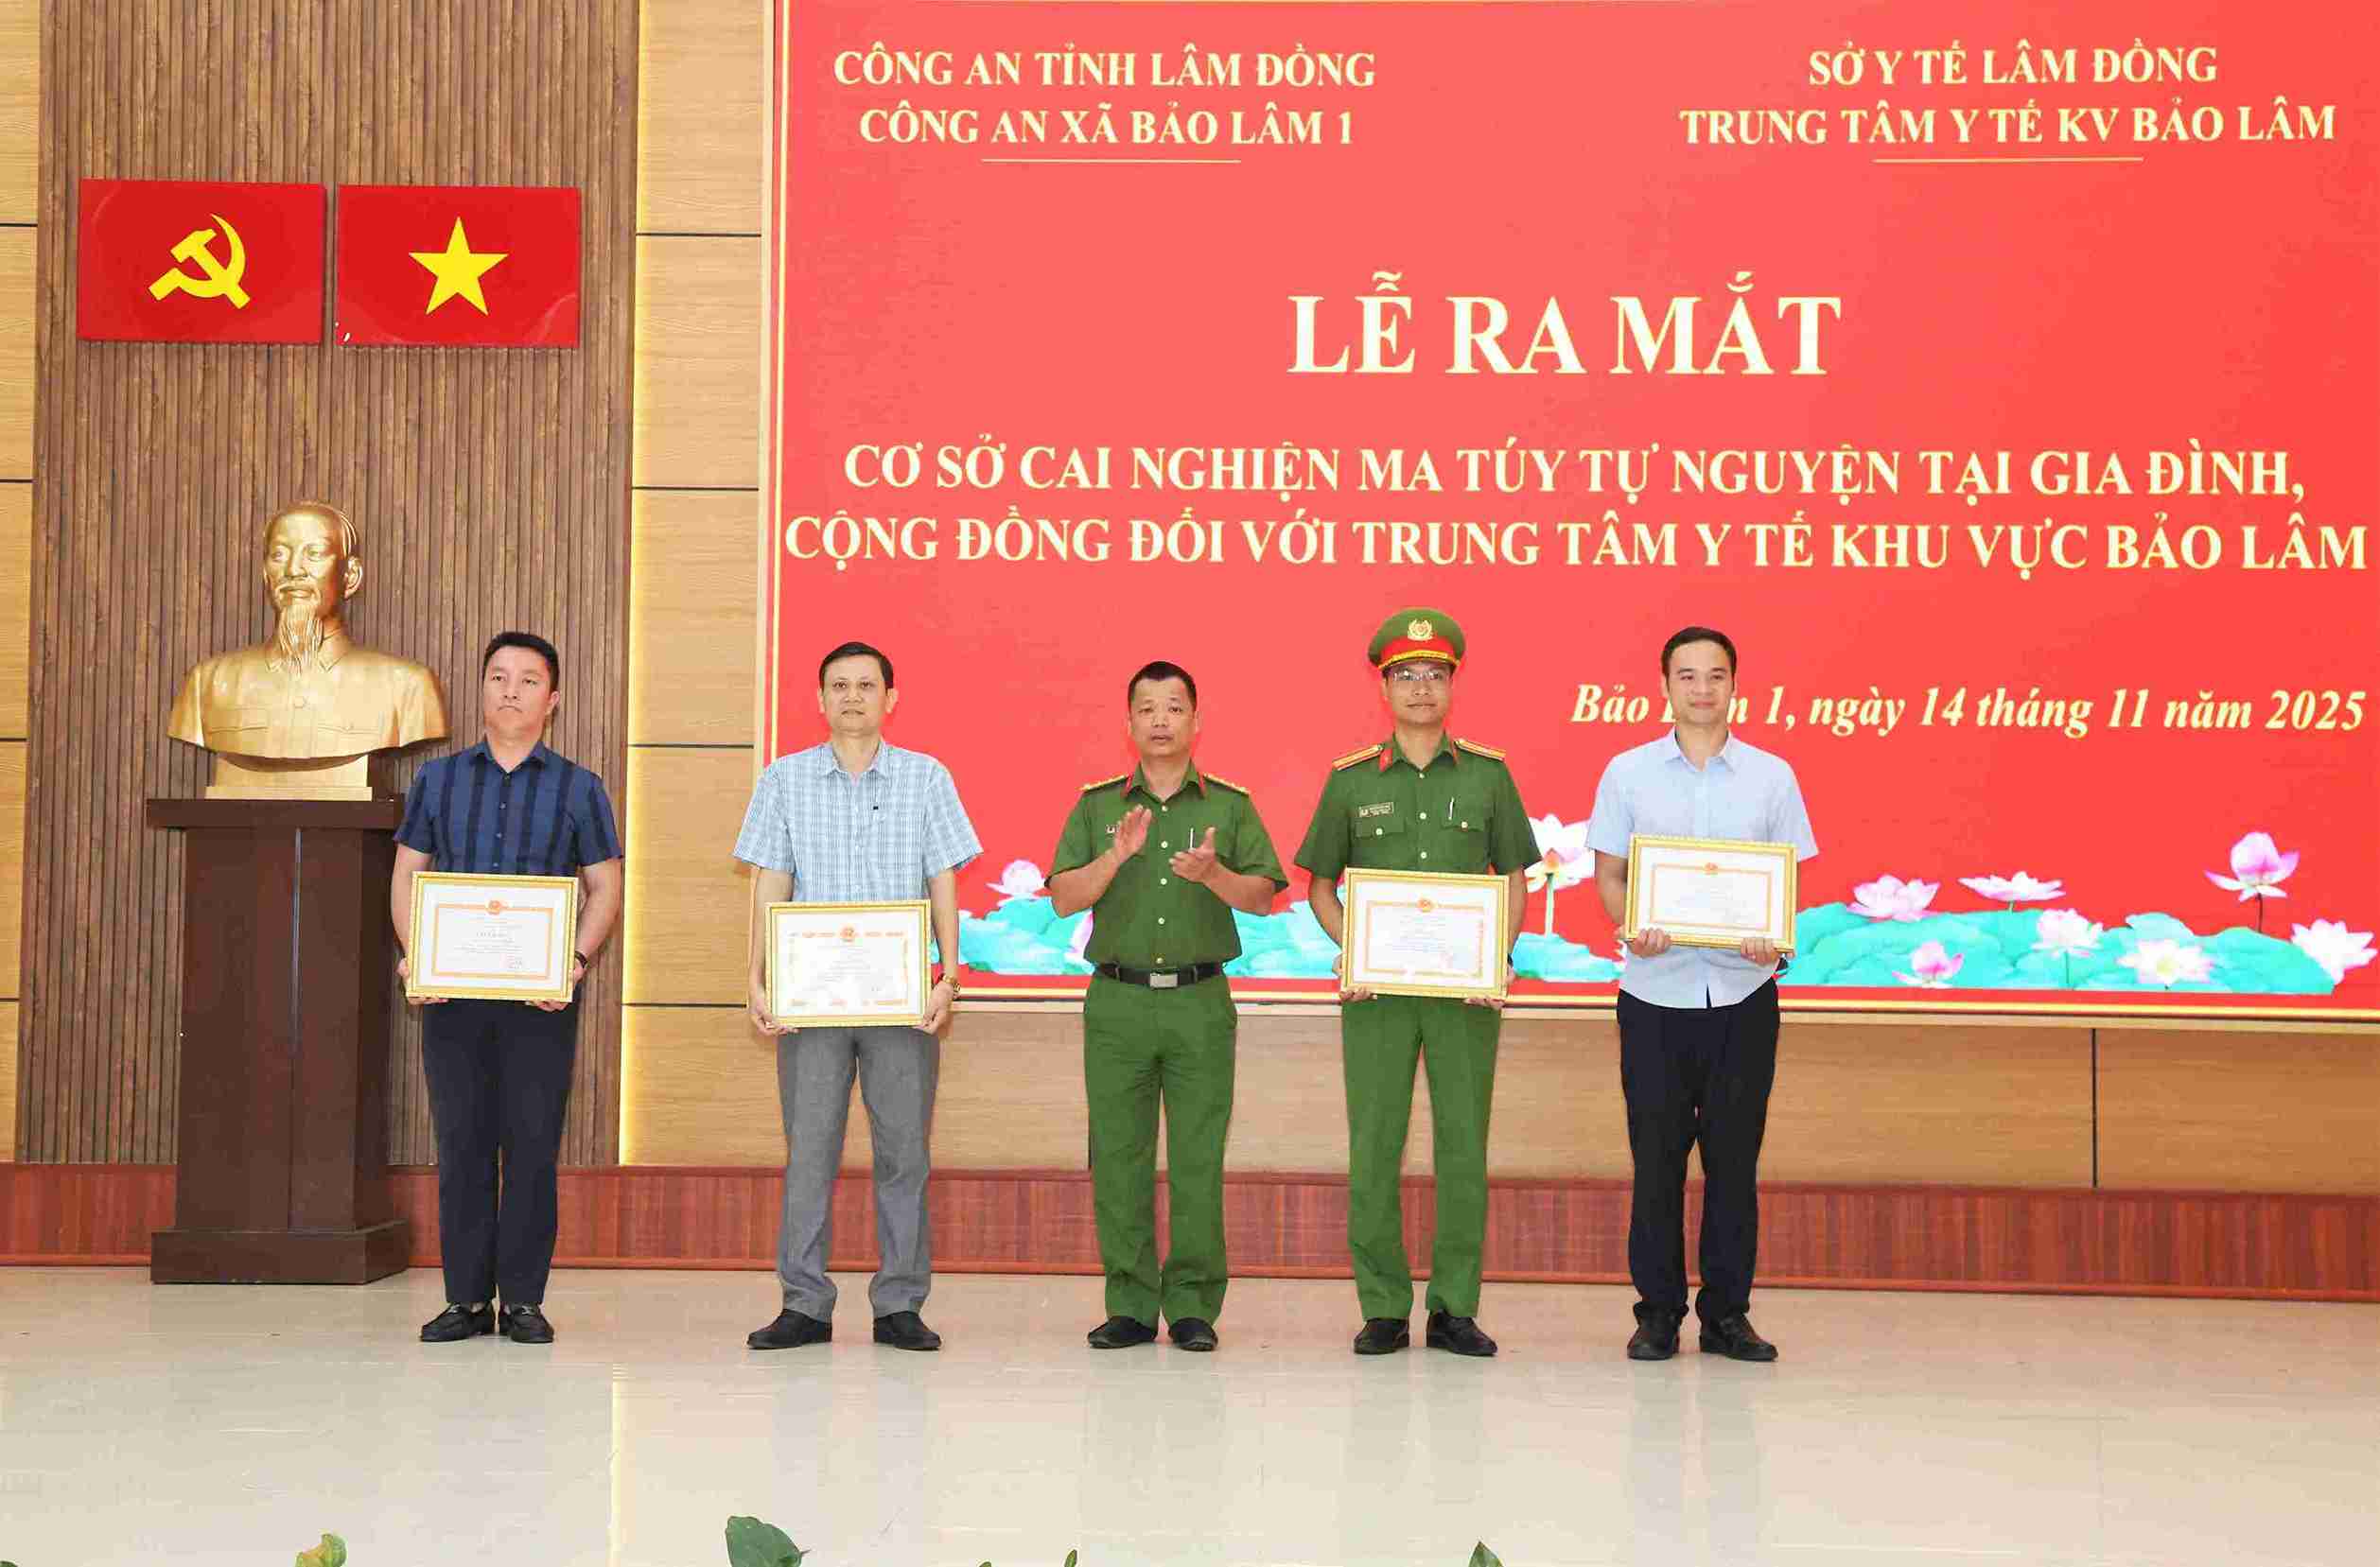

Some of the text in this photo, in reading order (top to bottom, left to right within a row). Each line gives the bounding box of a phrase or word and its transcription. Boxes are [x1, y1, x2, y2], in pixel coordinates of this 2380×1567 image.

[834, 41, 1375, 87] CÔNG AN TỈNH LÂM ĐỒNG
[1809, 37, 2217, 86] SỞ Y TẾ LÂM ĐỒNG
[860, 99, 1352, 145] CÔNG AN XÃ BẢO LÂM 1
[1679, 96, 2336, 145] TRUNG TÂM Y TẾ KV BẢO LÂM
[1286, 270, 1842, 375] LỄ RA MẮT
[844, 433, 2304, 506] CƠ SỞ CAI NGHIỆN MA TÚY TỰ NGUYỆN TẠI GIA ĐÌNH,
[785, 504, 2367, 581] CỘNG ĐỒNG ĐỐI VỚI TRUNG TÂM Y TẾ KHU VỰC BẢO LÂM
[1570, 684, 1650, 723] Bảo
[1765, 686, 1795, 730] 1,
[1809, 686, 1906, 737] ngày
[1921, 688, 1967, 727] 14
[1976, 687, 2094, 739] tháng
[2108, 688, 2149, 727] 11
[2163, 689, 2252, 729] năm
[2265, 689, 2367, 731] 2025
